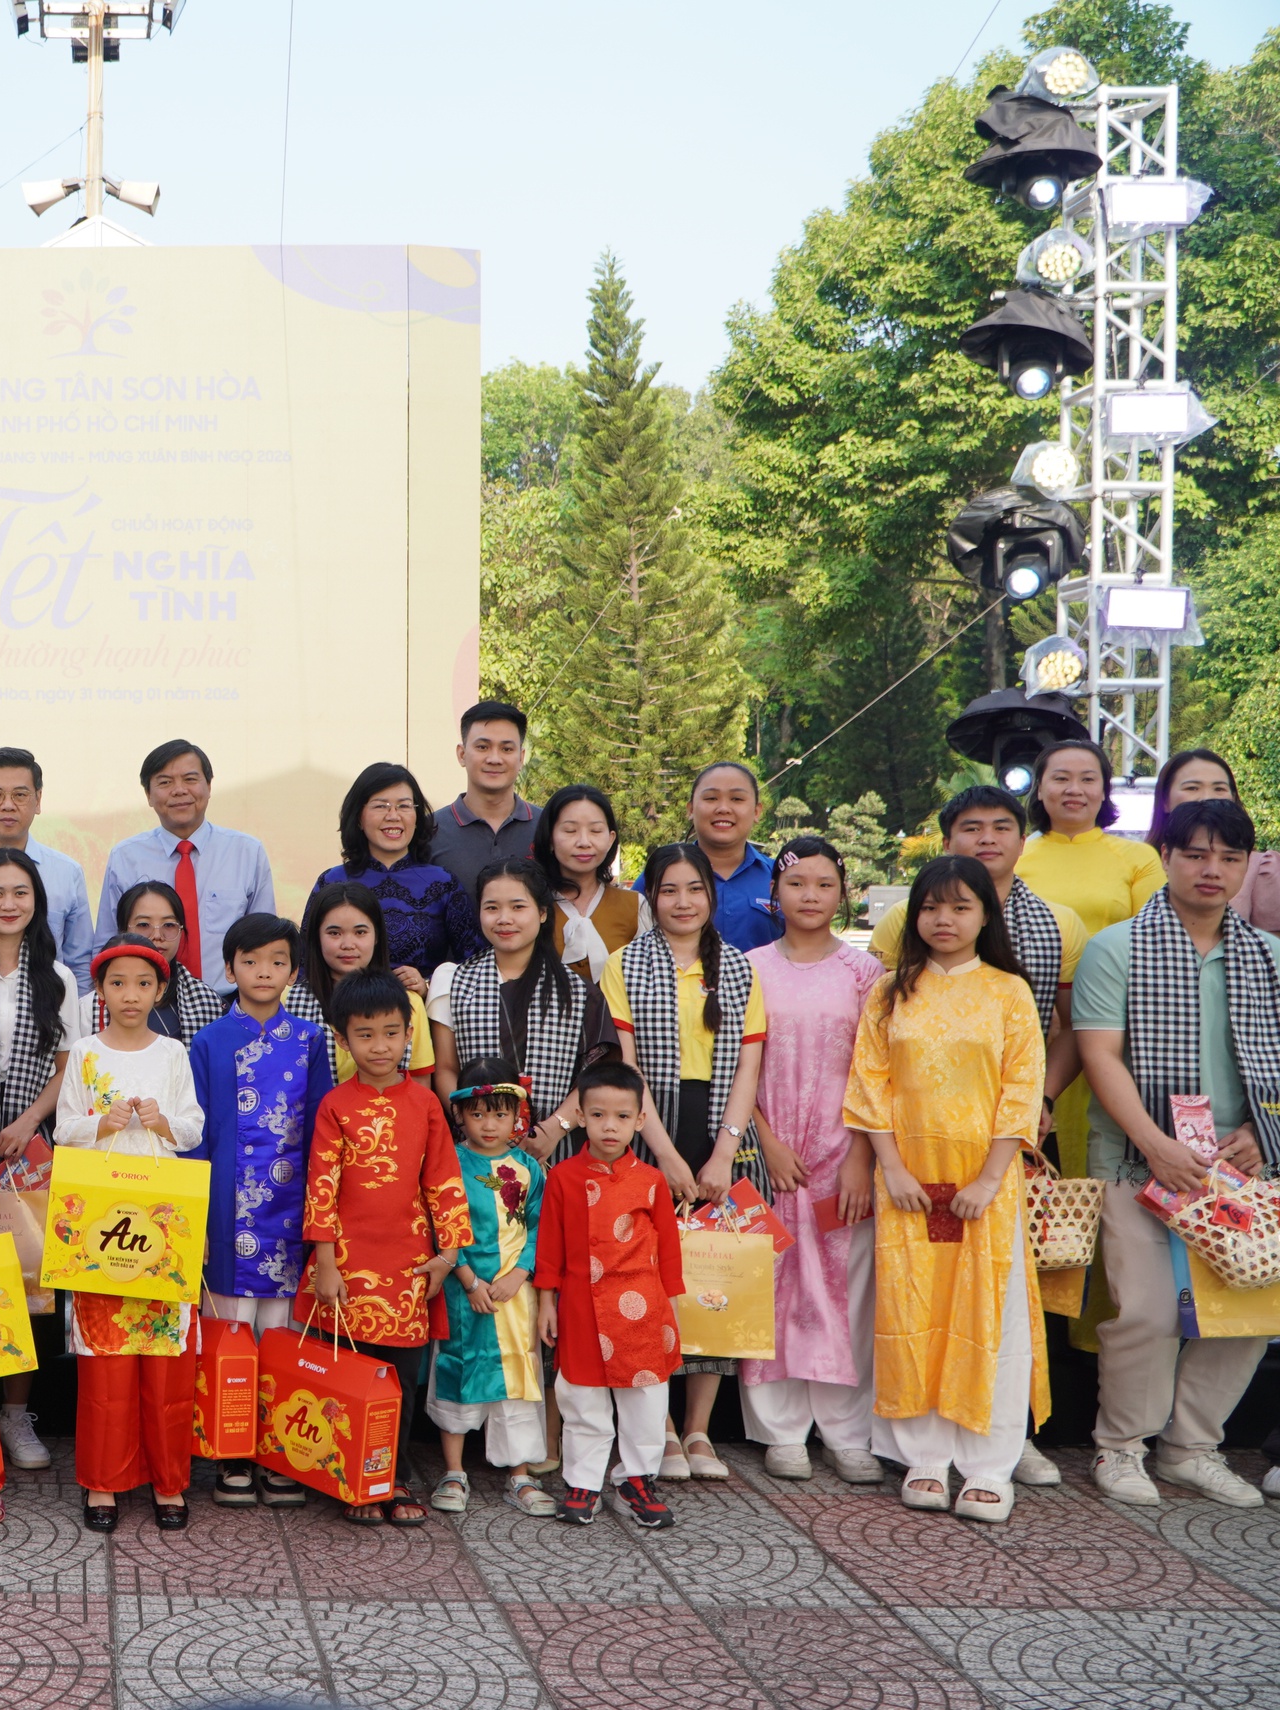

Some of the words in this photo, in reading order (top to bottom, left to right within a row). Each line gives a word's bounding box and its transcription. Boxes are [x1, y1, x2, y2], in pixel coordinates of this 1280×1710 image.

[55, 370, 112, 402] TÂN
[122, 373, 186, 401] SƠN
[196, 368, 262, 401] HÒA
[37, 408, 80, 433] PHỐ
[86, 407, 118, 432] HỒ
[124, 410, 159, 432] CHÍ
[165, 415, 218, 432] MINH
[40, 451, 74, 463] VINH
[89, 448, 133, 463] MỪNG
[137, 448, 176, 463] XUÂN
[180, 447, 213, 463] BÍNH
[217, 450, 253, 466] NGỌ
[257, 450, 292, 462] 2026
[111, 513, 158, 532] CHUỖI
[162, 518, 203, 535] HOẠT
[208, 516, 254, 534] ĐỘNG
[113, 544, 256, 581] NGHĨA
[129, 585, 237, 621] TÌNH
[93, 634, 170, 672] hạnh
[172, 634, 251, 678] phúc
[36, 687, 75, 704] ngày
[79, 687, 93, 700] 31
[98, 687, 142, 704] tháng
[146, 687, 160, 700] 01
[165, 687, 200, 700] năm
[204, 687, 239, 700] 2026
[121, 1172, 149, 1181] ORION
[99, 1217, 152, 1253] An
[690, 1251, 734, 1260] IMPERIAL
[305, 1361, 327, 1375] ORION
[284, 1405, 323, 1444] An
